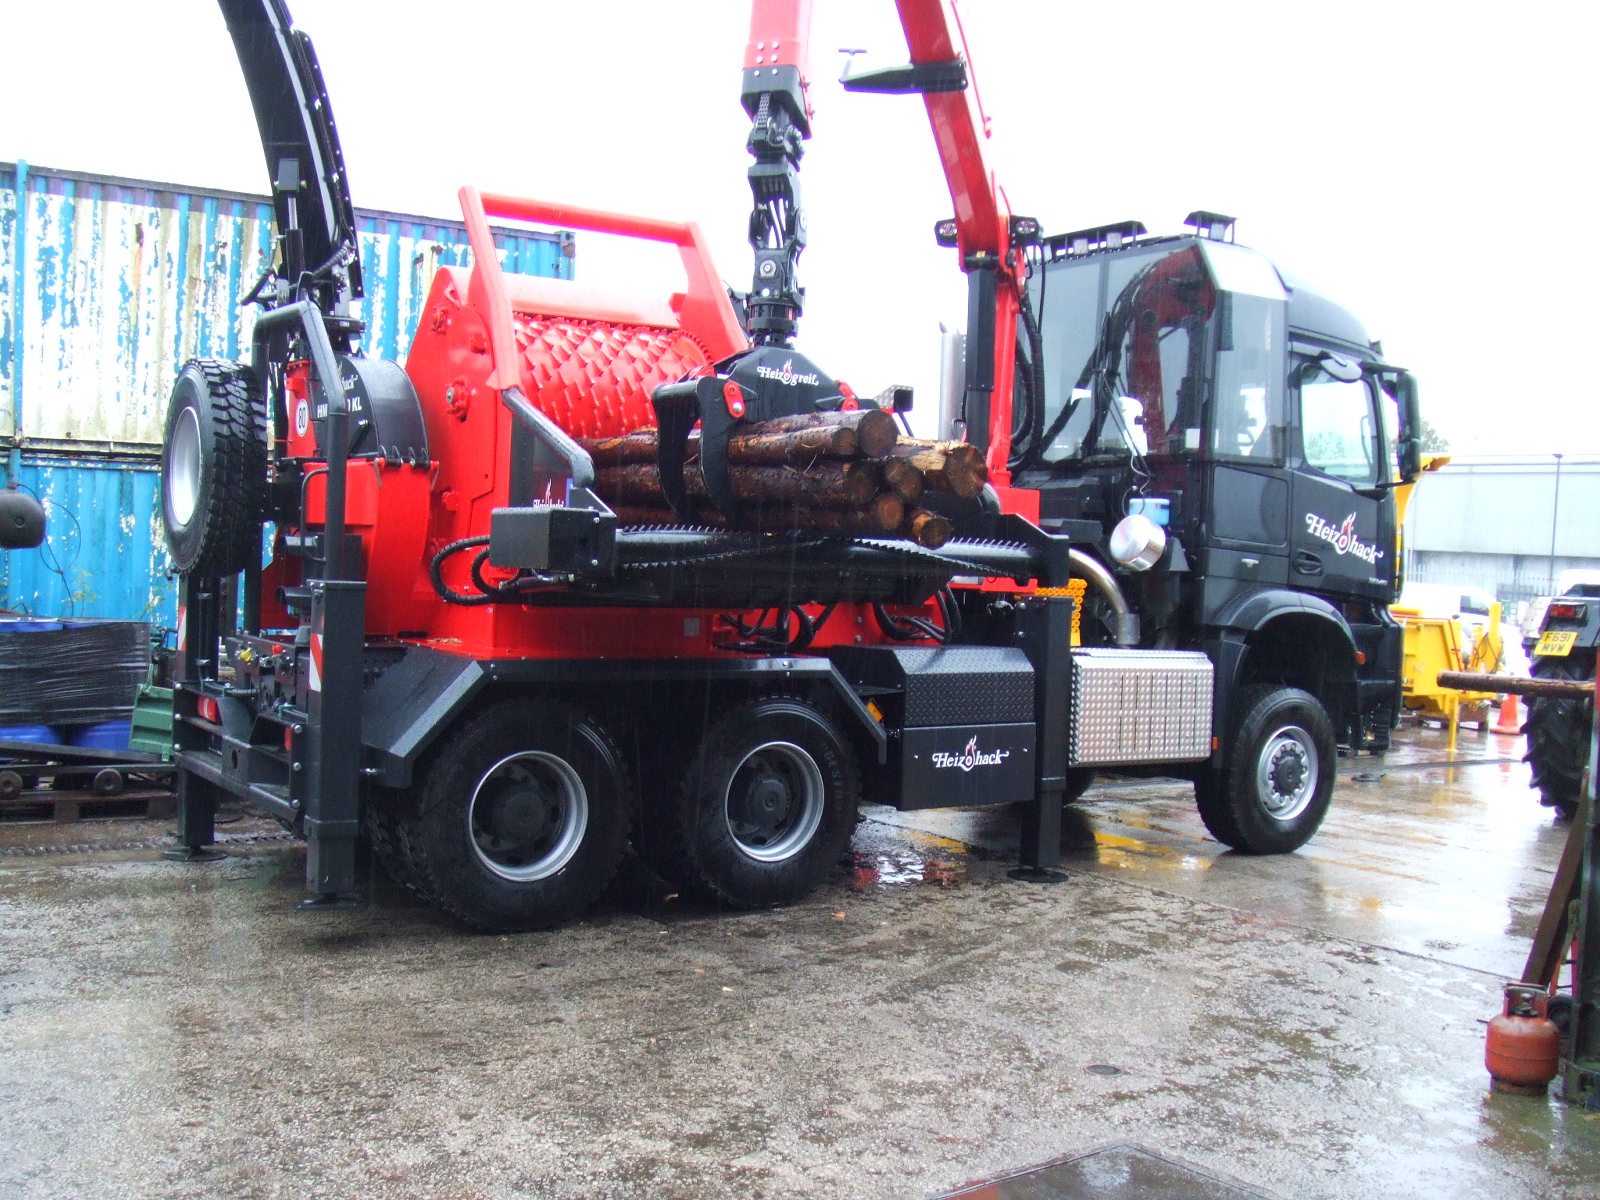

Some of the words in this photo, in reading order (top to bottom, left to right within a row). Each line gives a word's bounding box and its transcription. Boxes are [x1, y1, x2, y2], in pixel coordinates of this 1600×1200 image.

[352, 396, 362, 412] KL
[1305, 512, 1384, 565] Heizohack
[1544, 632, 1572, 642] F691
[932, 747, 1009, 772] Heizohack
